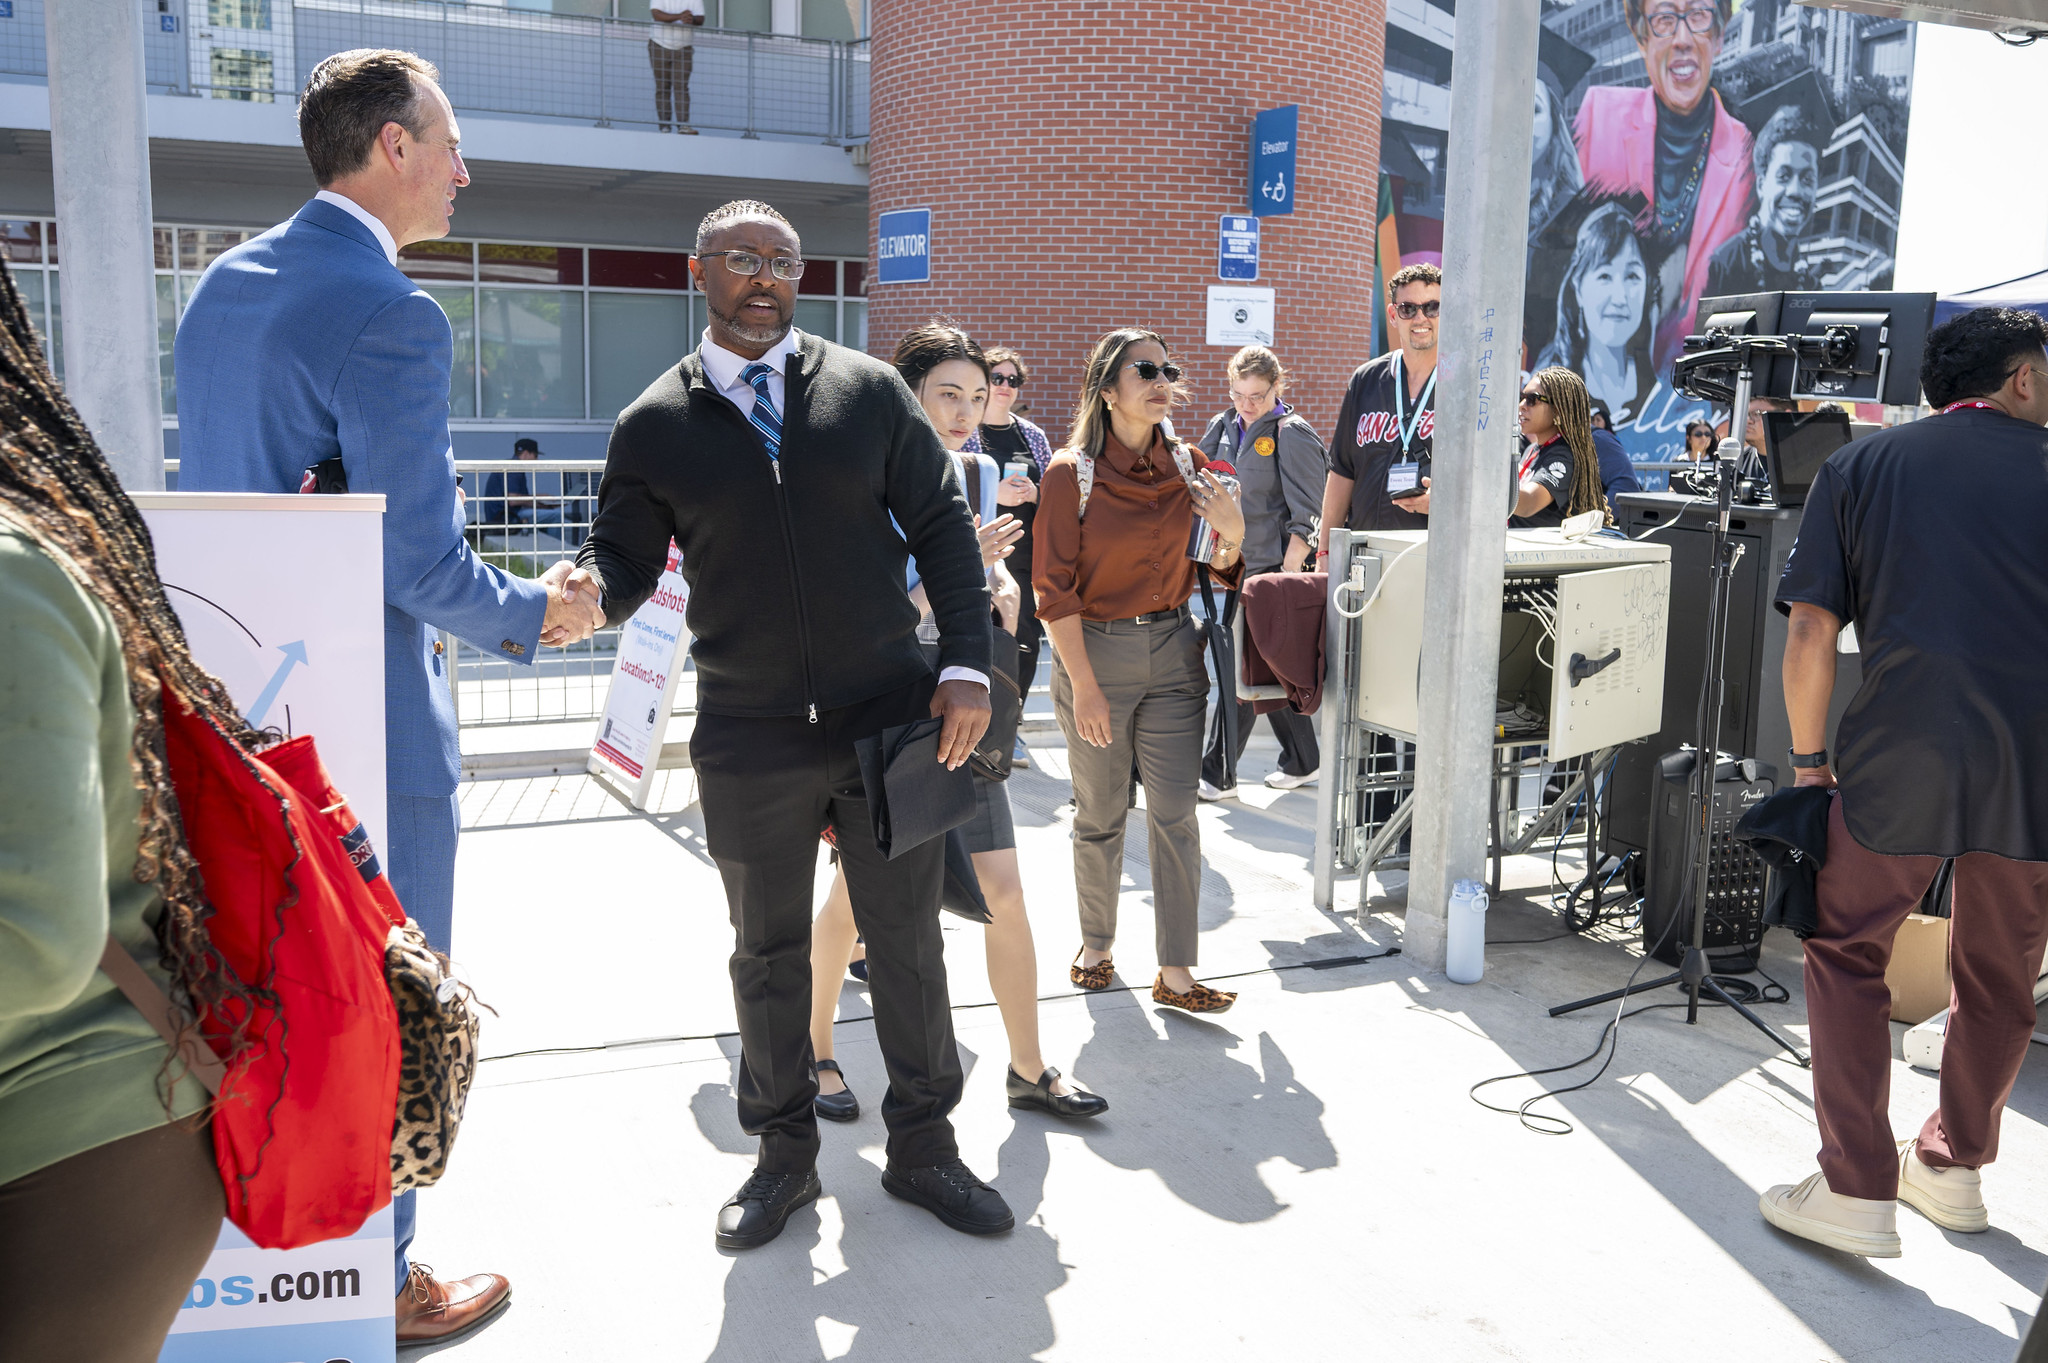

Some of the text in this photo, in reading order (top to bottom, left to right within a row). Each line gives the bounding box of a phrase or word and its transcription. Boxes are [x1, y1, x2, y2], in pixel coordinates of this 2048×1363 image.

[1261, 141, 1289, 155] Elevator
[1232, 219, 1247, 231] NO
[880, 234, 926, 259] ELEVATOR
[1789, 299, 1816, 308] acer
[1357, 411, 1390, 447] SAN
[650, 585, 686, 613] adshots
